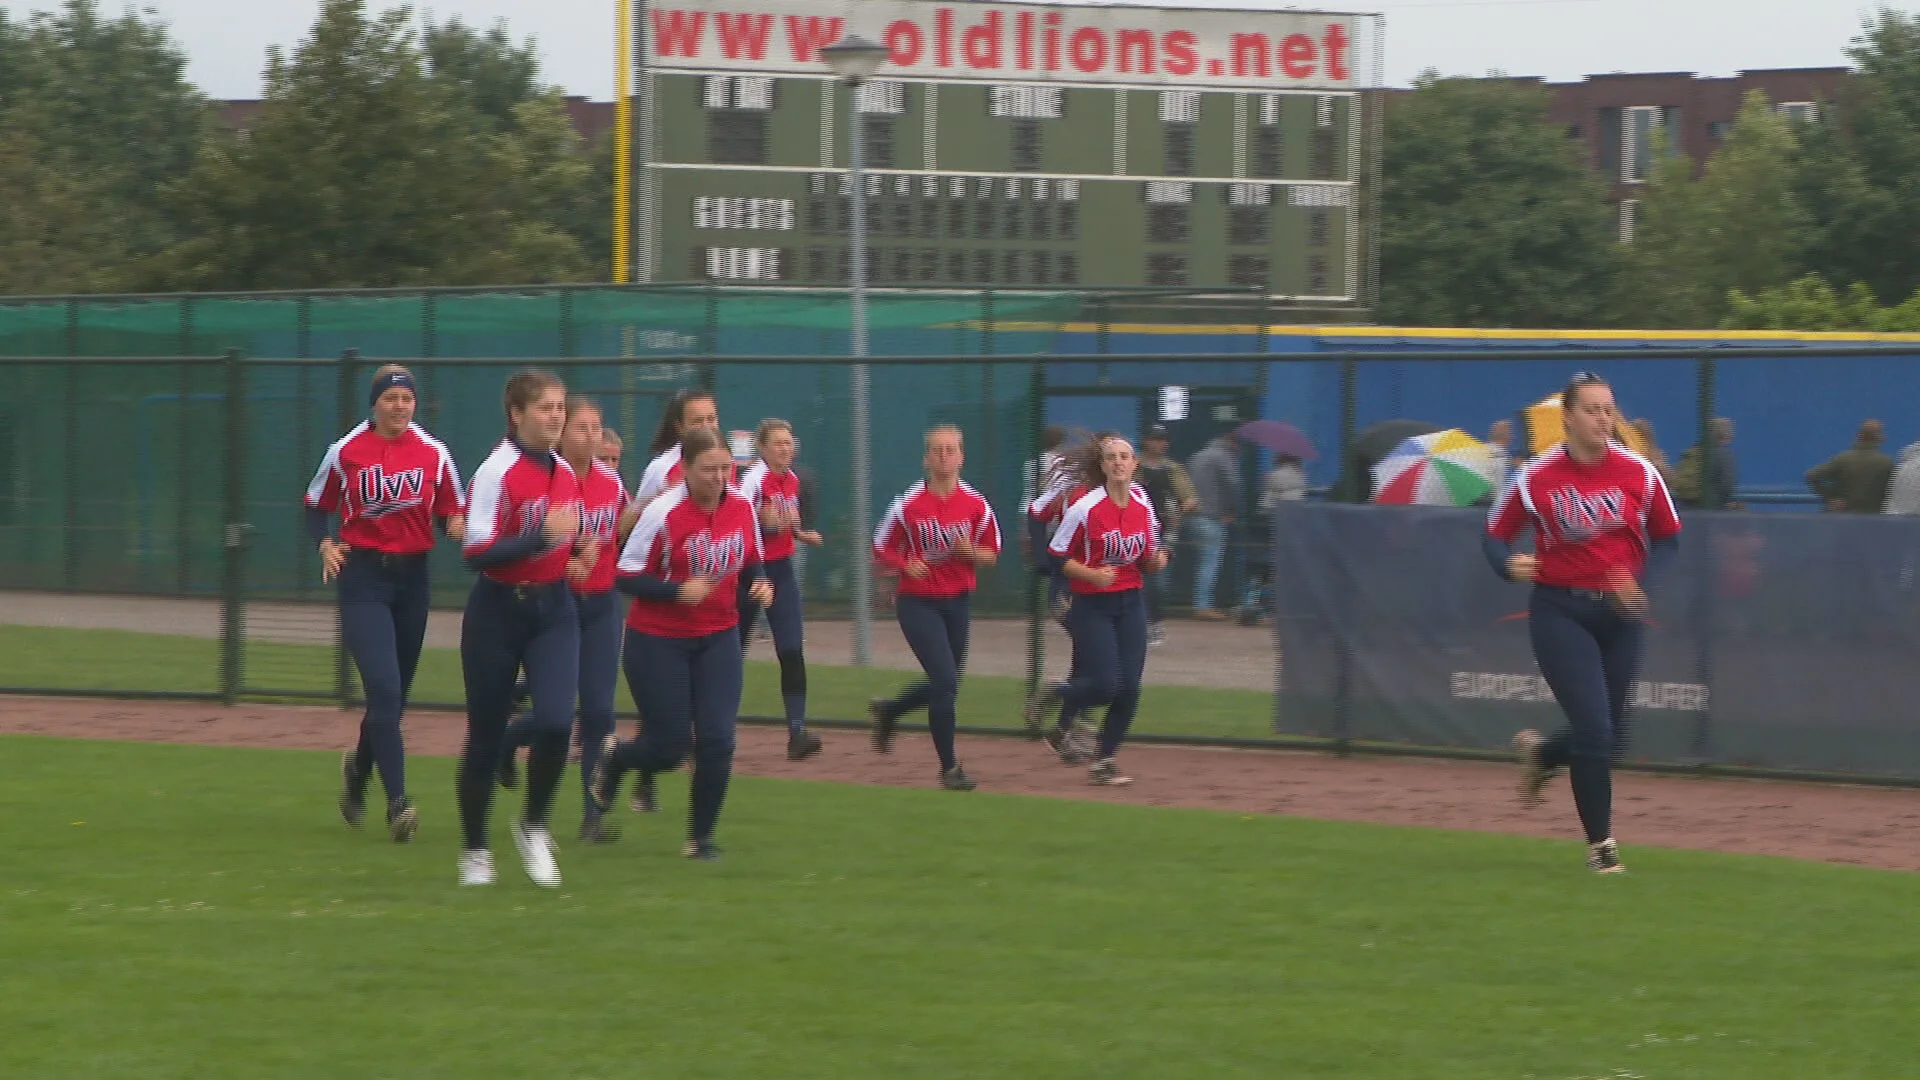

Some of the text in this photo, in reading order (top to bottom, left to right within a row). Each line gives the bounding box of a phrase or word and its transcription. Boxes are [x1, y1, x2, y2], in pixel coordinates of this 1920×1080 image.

[649, 8, 1350, 81] wwwoldlions.net
[693, 196, 796, 231] GUESTS
[1451, 671, 1556, 701] EUROPEA
